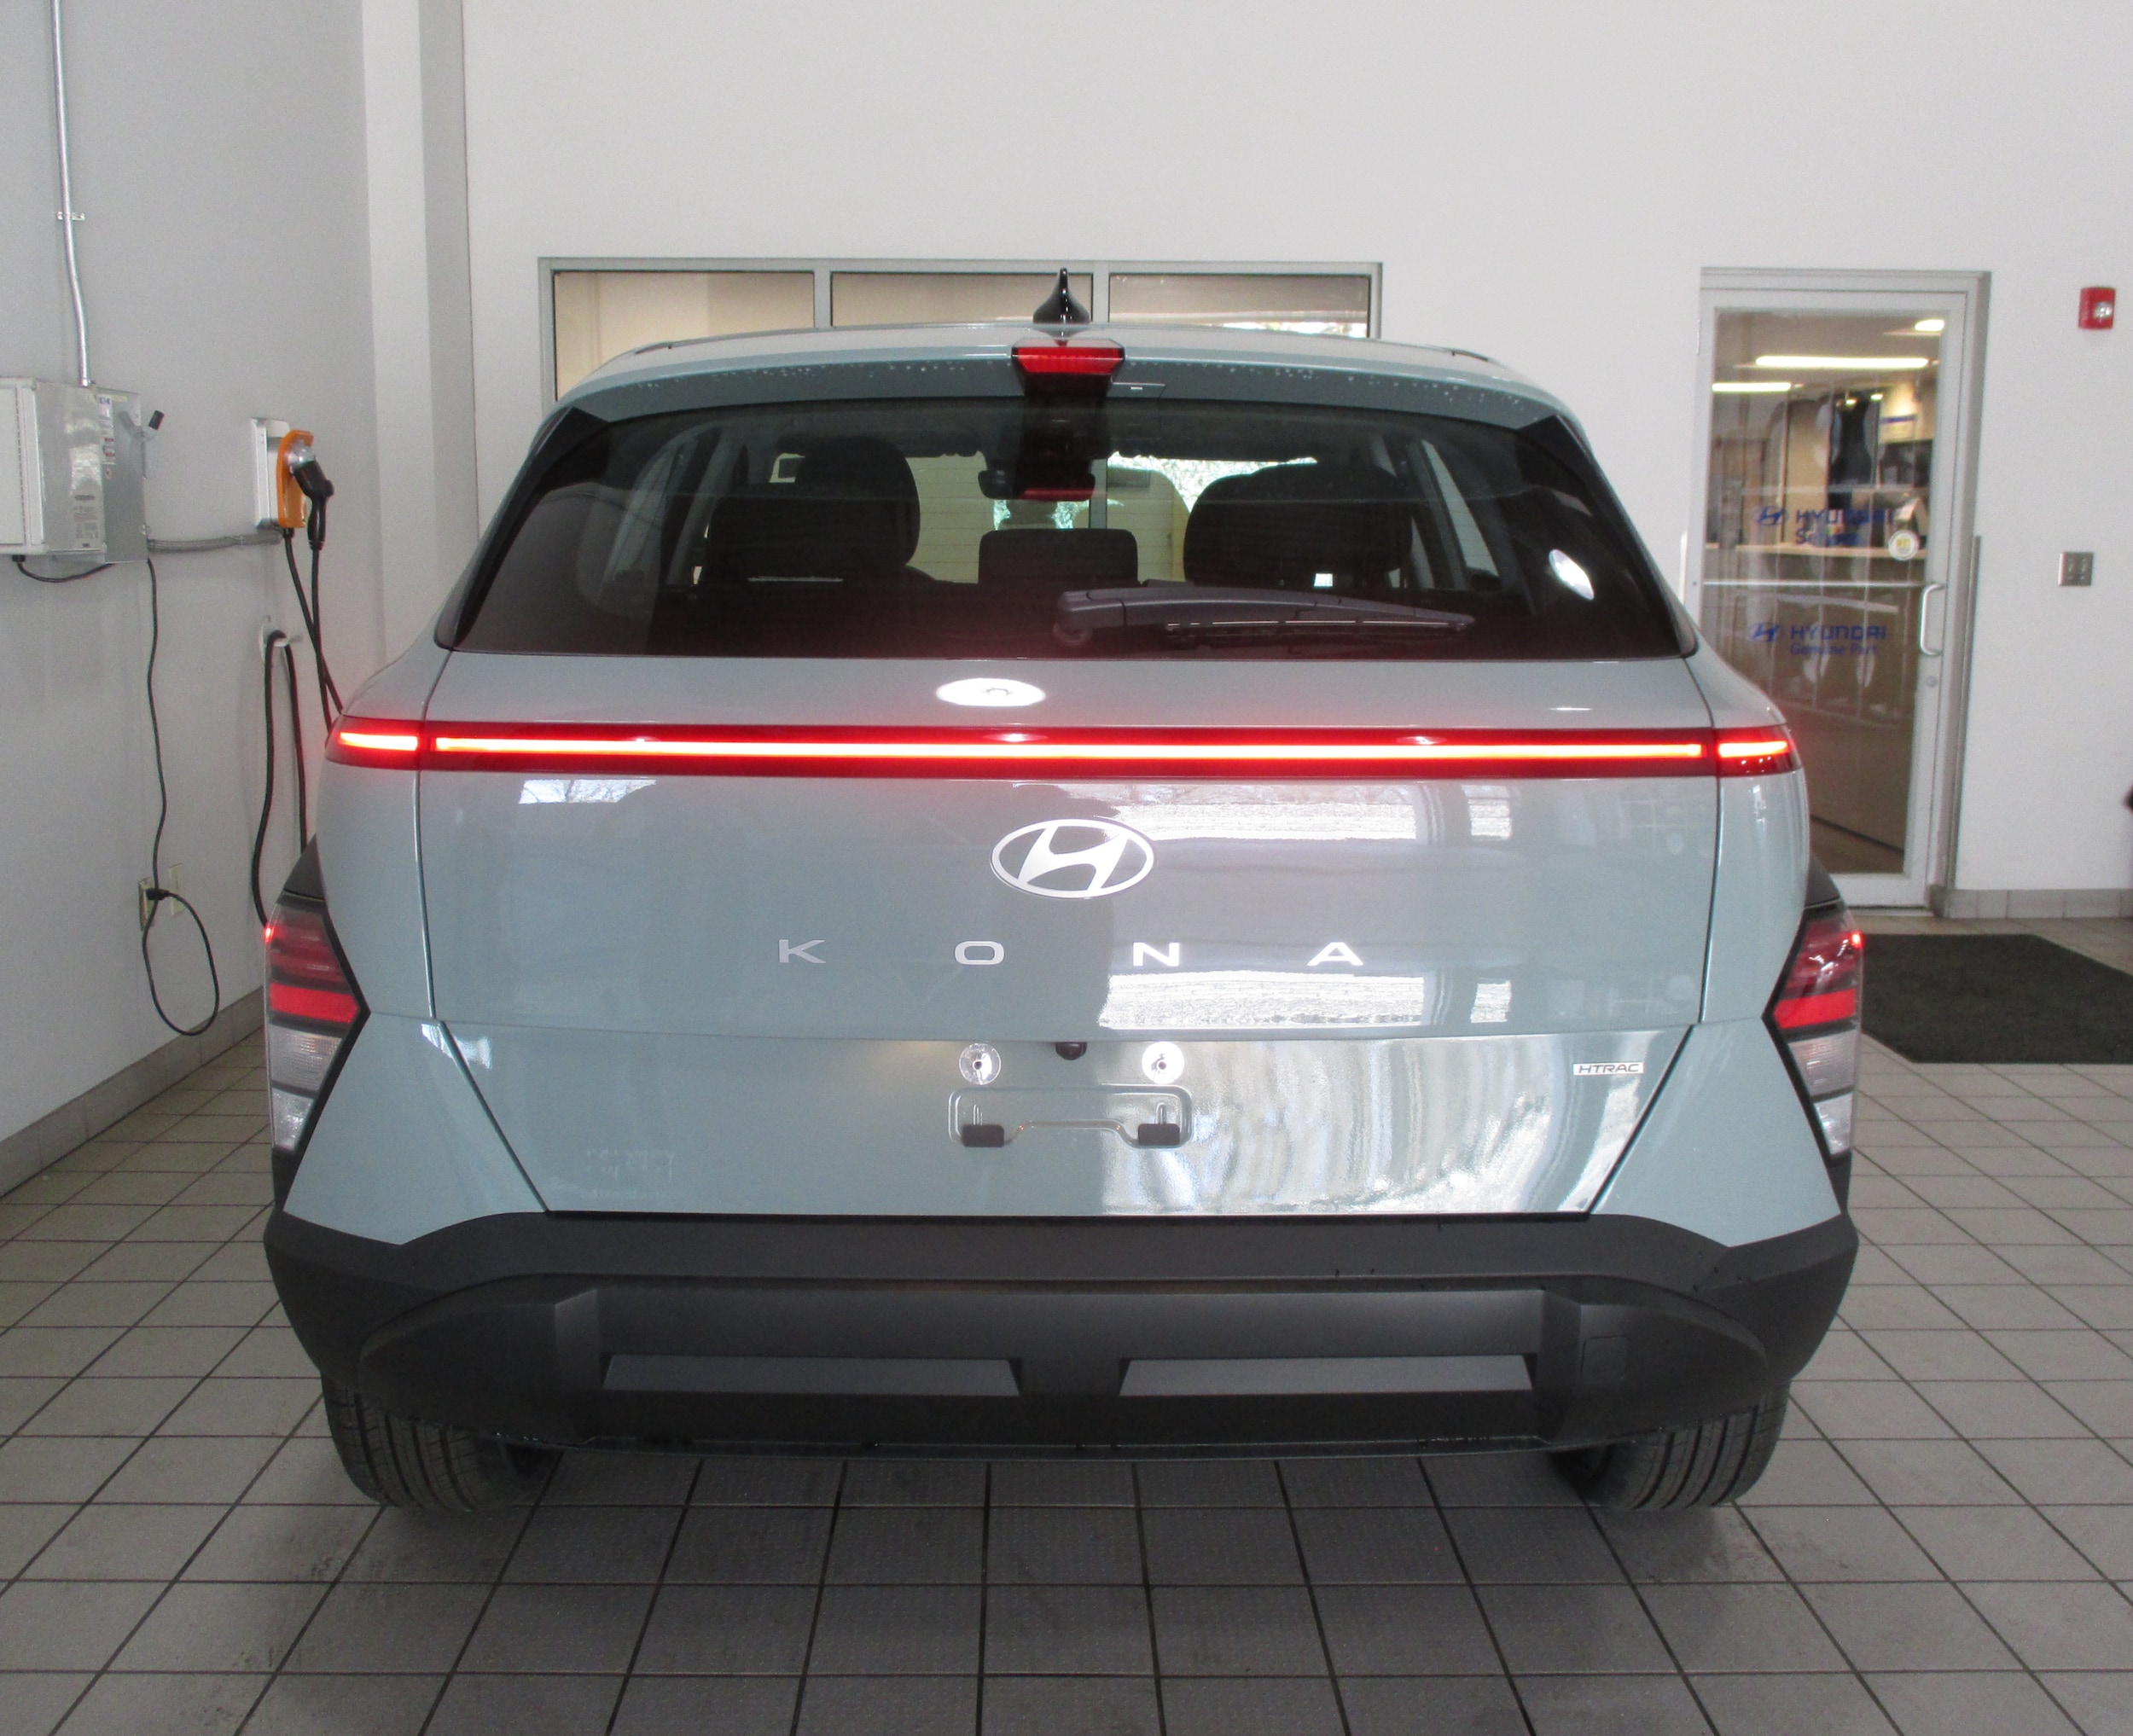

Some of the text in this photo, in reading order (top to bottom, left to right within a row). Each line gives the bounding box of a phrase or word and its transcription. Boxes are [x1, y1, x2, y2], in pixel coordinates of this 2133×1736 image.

[1790, 624, 1887, 640] HYUNDAI
[777, 938, 1364, 967] KONA
[1578, 1064, 1640, 1074] HTRAC
